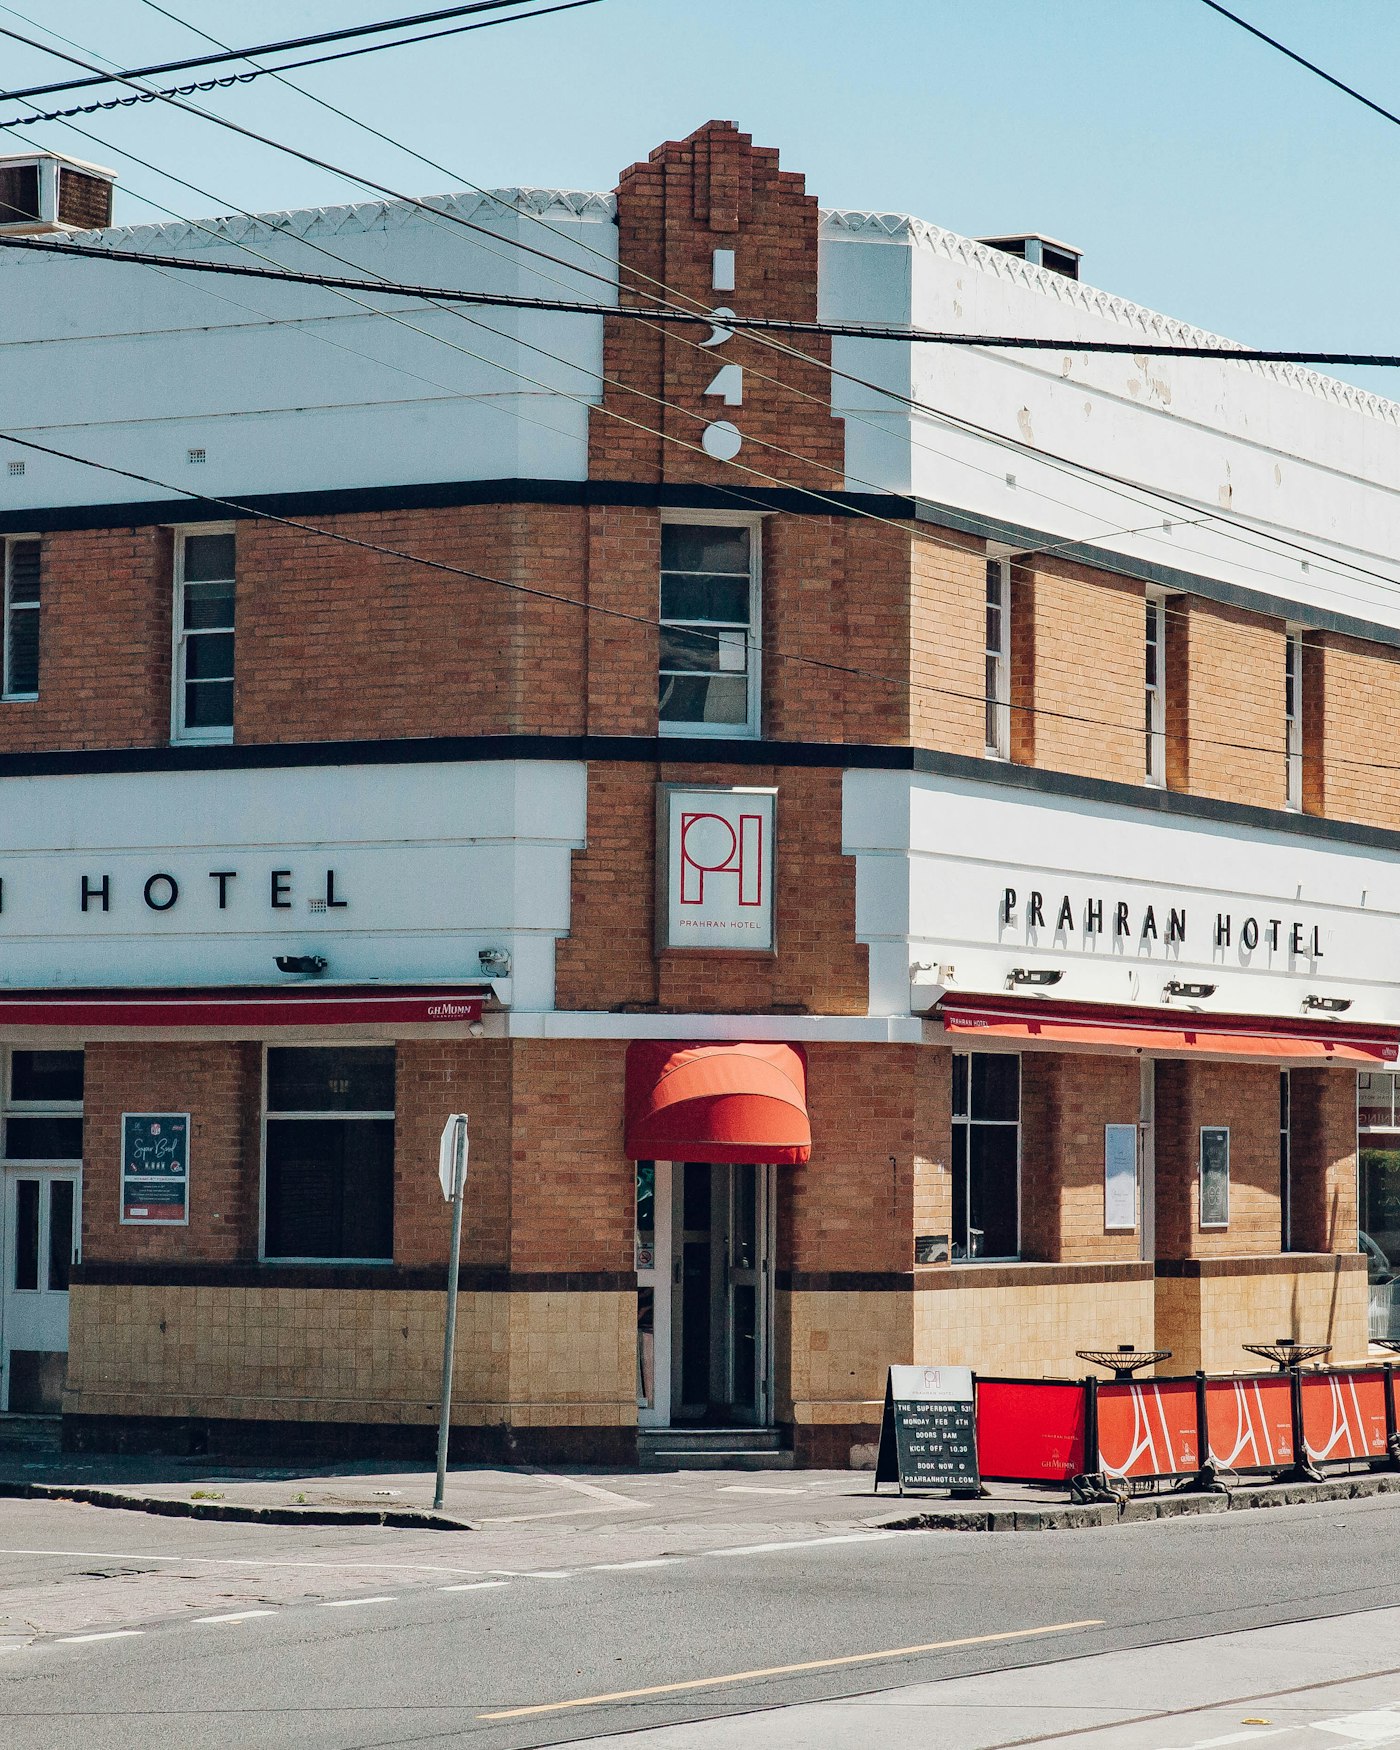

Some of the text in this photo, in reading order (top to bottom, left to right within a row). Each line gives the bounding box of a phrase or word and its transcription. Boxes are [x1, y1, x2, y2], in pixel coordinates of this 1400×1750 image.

[81, 869, 348, 912] HOTEL
[679, 919, 762, 929] PRAHRAN HOTEL
[1003, 887, 1325, 957] PRAHRAN HOTEL
[917, 1405, 957, 1413] SUPERBOWL
[904, 1476, 974, 1484] PRAHRANHOTEL.COM
